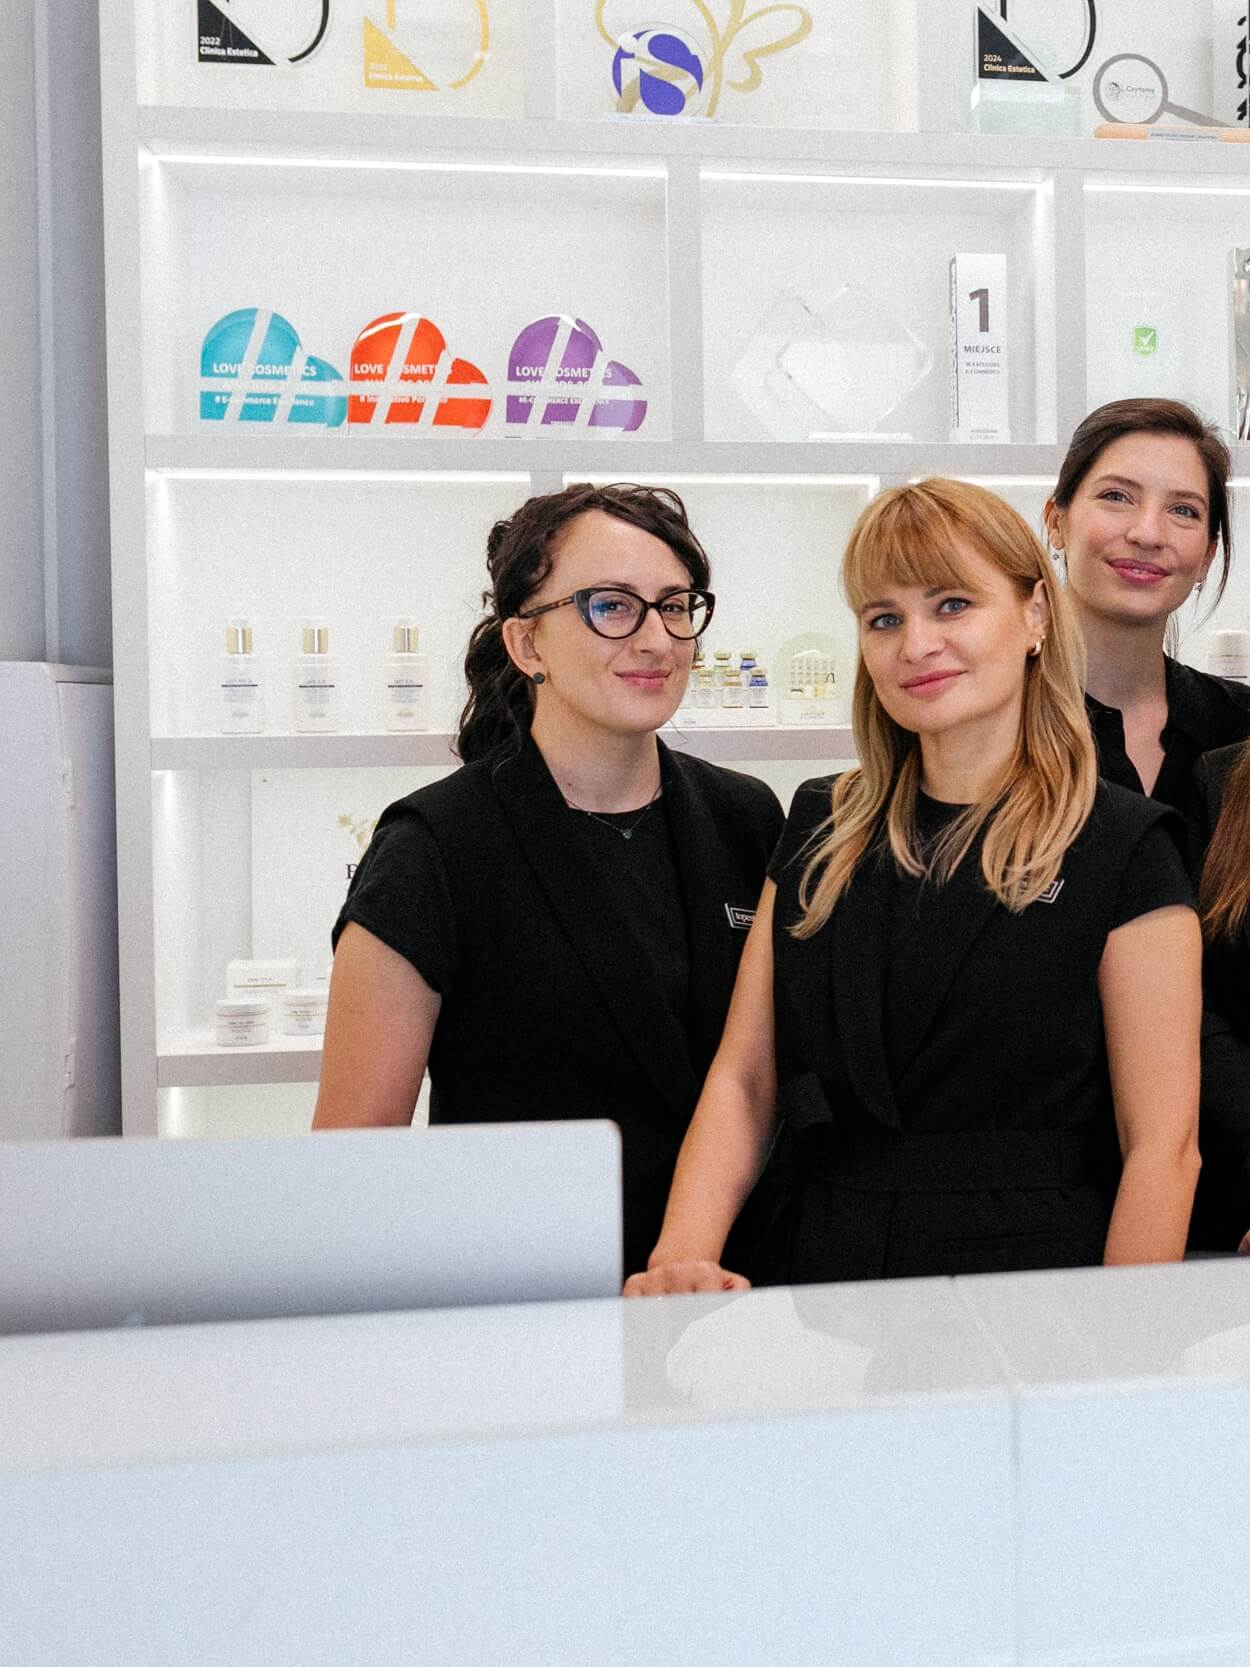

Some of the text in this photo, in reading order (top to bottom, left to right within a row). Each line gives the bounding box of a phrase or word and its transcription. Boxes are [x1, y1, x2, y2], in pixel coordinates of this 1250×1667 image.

[983, 54, 1002, 63] 2024
[983, 63, 1007, 73] Clinica
[969, 288, 989, 332] 1
[963, 345, 1001, 354] MIEJSCE
[354, 363, 384, 375] LOVE
[515, 366, 546, 378] LOVE
